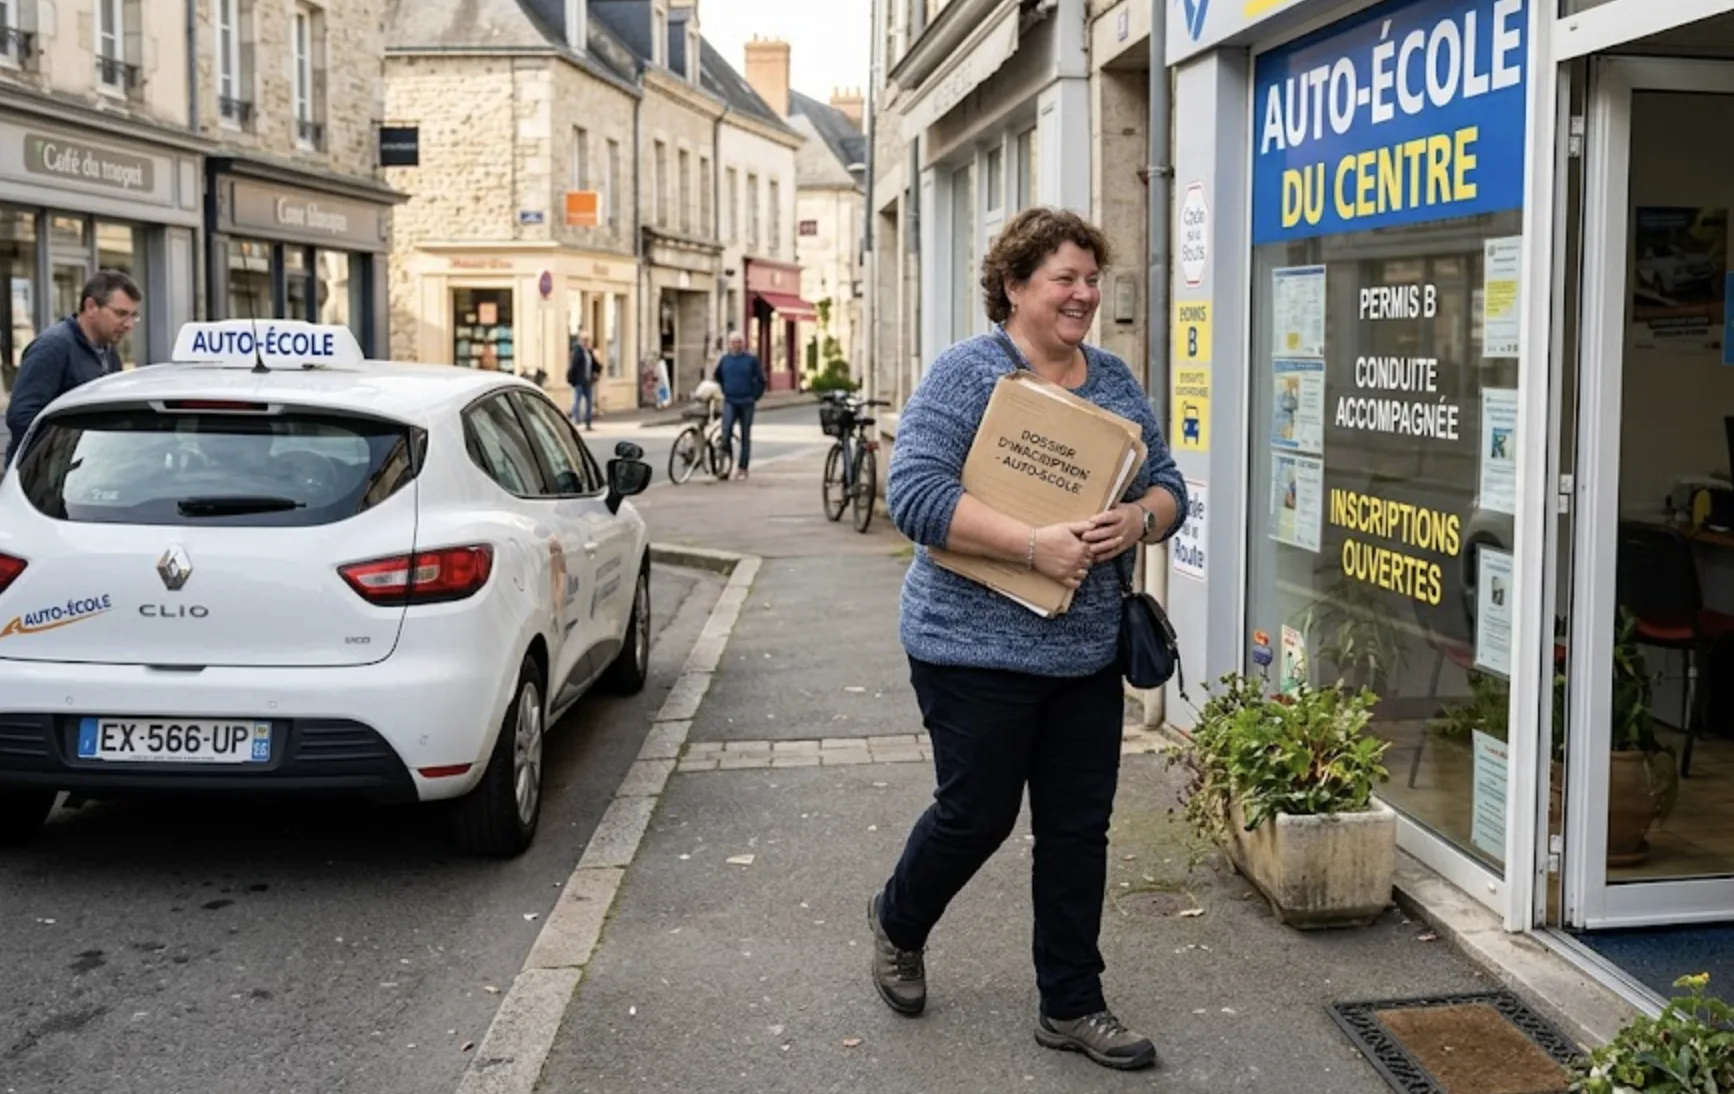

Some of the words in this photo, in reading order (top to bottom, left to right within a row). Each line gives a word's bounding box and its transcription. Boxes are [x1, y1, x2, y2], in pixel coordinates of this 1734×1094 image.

[1261, 0, 1522, 155] AUTO-ÉCOLE
[1282, 162, 1325, 228] DU
[1334, 126, 1478, 220] CENTRE
[1360, 285, 1420, 320] PERMIS
[1424, 284, 1437, 318] B
[192, 326, 334, 356] AUTO-ÉCOLE
[1188, 326, 1197, 357] B
[1355, 356, 1438, 392] CONDUITE
[1335, 395, 1459, 440] ACCOMPAGNÉE
[1330, 488, 1460, 556] INSCRIPTIONS
[1343, 538, 1441, 605] OUVERTES
[24, 594, 112, 627] AUTO-ÉCOLE
[139, 604, 209, 618] CLIO
[101, 723, 249, 754] EX-566-UP
